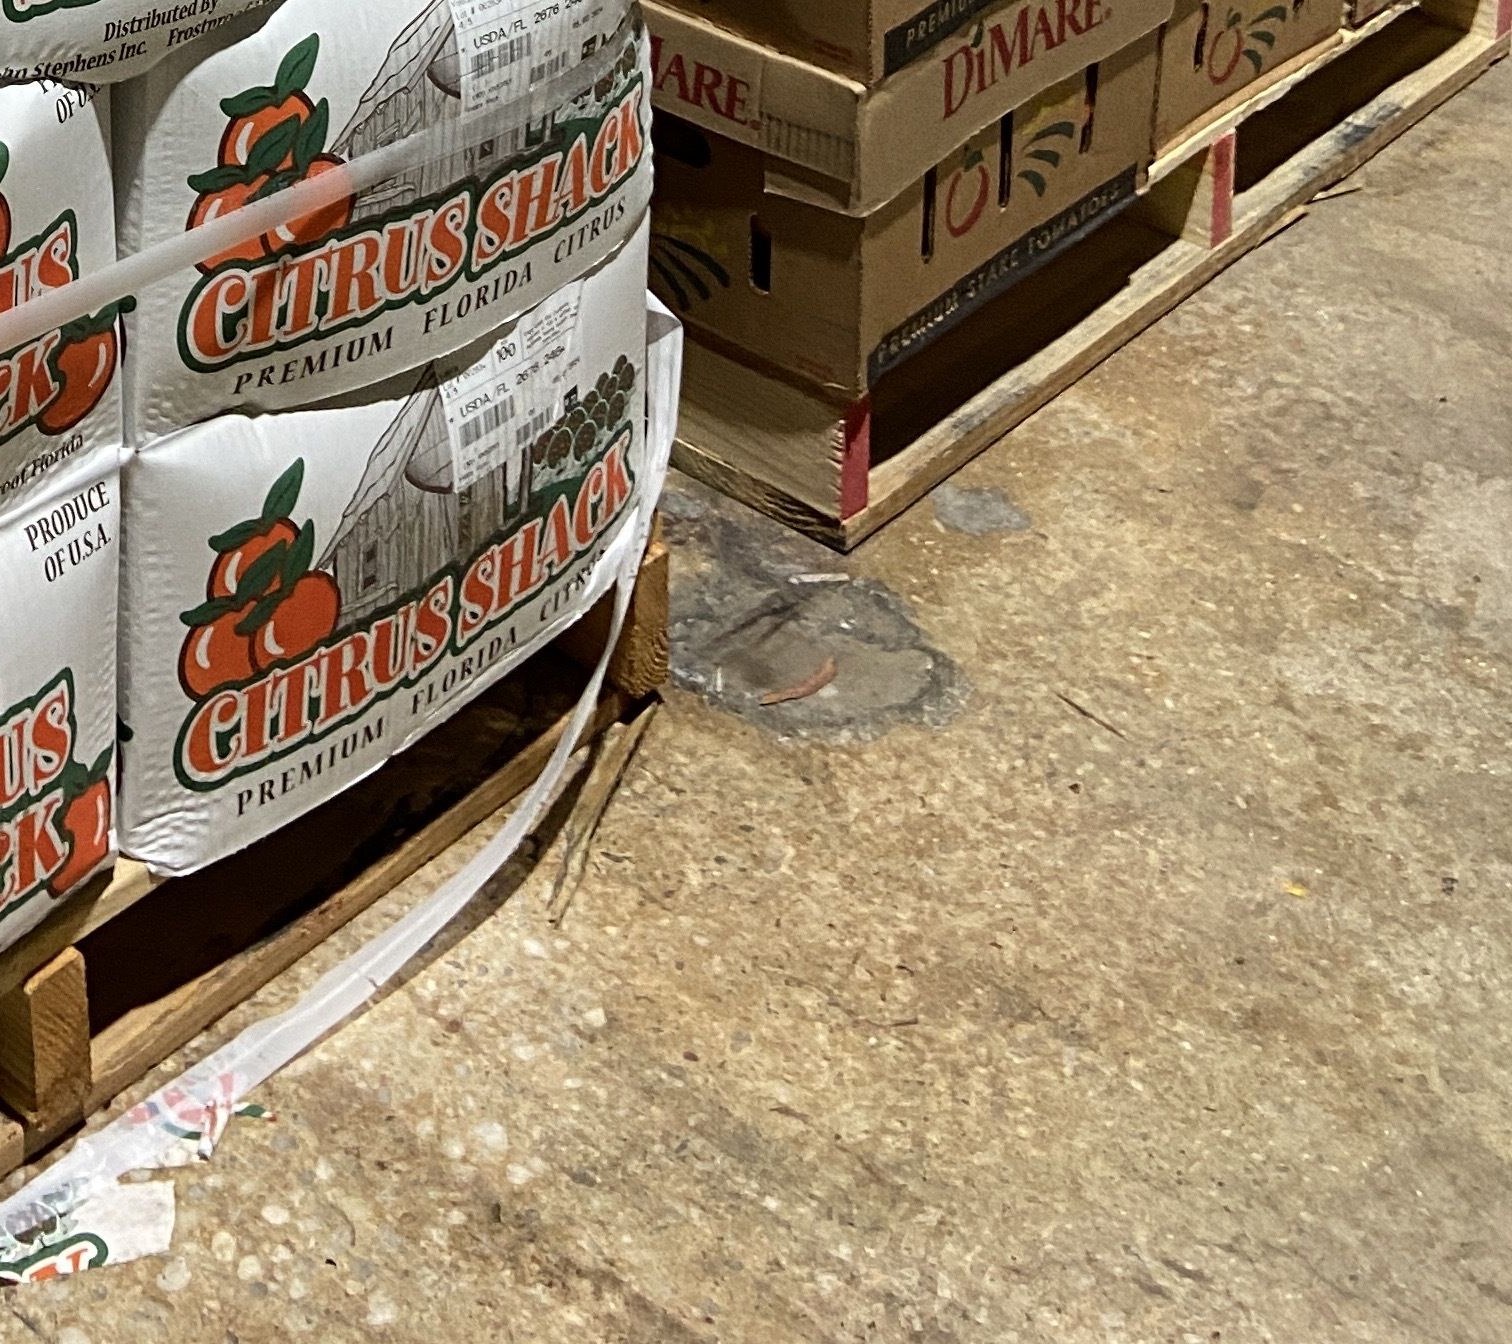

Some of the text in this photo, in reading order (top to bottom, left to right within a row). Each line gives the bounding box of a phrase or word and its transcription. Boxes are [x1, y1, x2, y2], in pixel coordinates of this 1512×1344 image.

[103, 1, 192, 44] Distributed
[190, 80, 644, 361] CITRUS SHACK
[233, 324, 394, 395] PREMIUM
[422, 262, 534, 334] FLORIDA
[23, 481, 111, 553] PRODUCE
[43, 548, 71, 585] OF
[186, 436, 632, 776] CITRUS SHACK
[236, 629, 518, 817] PREMIUM FLORIDA
